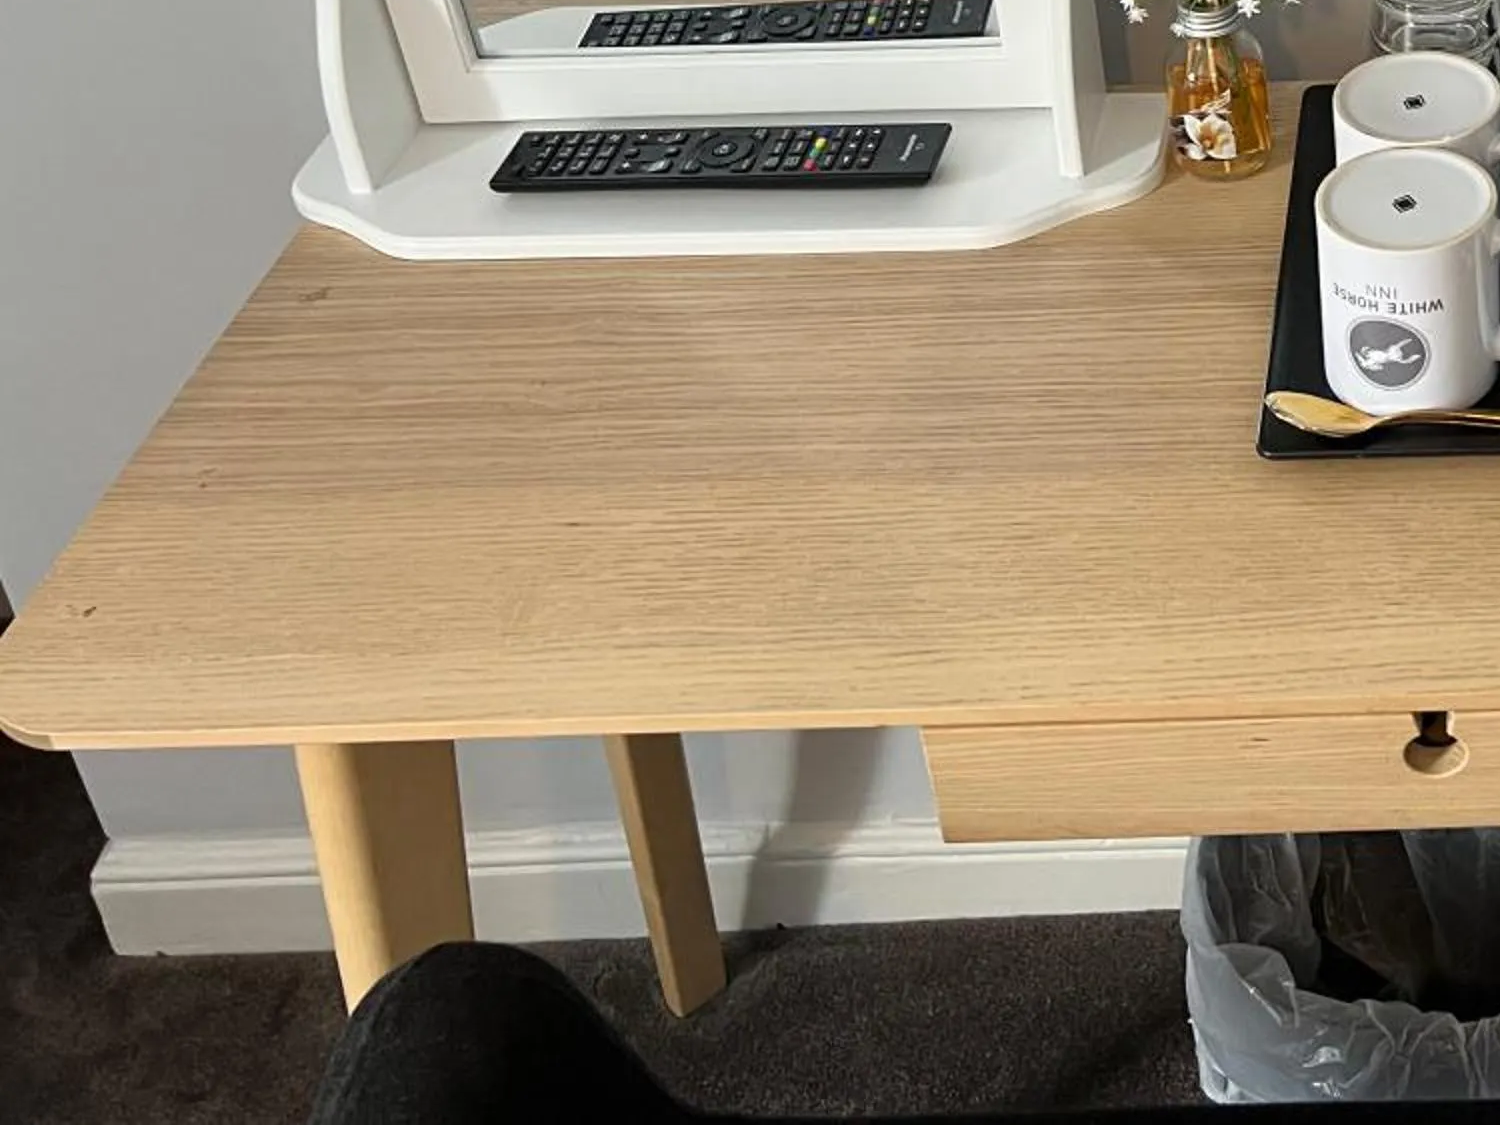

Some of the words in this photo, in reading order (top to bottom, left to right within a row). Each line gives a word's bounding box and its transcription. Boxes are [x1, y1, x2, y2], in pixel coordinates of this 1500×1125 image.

[1331, 282, 1379, 312] HORSE
[1365, 284, 1398, 301] INN
[1387, 298, 1445, 316] WHITE
